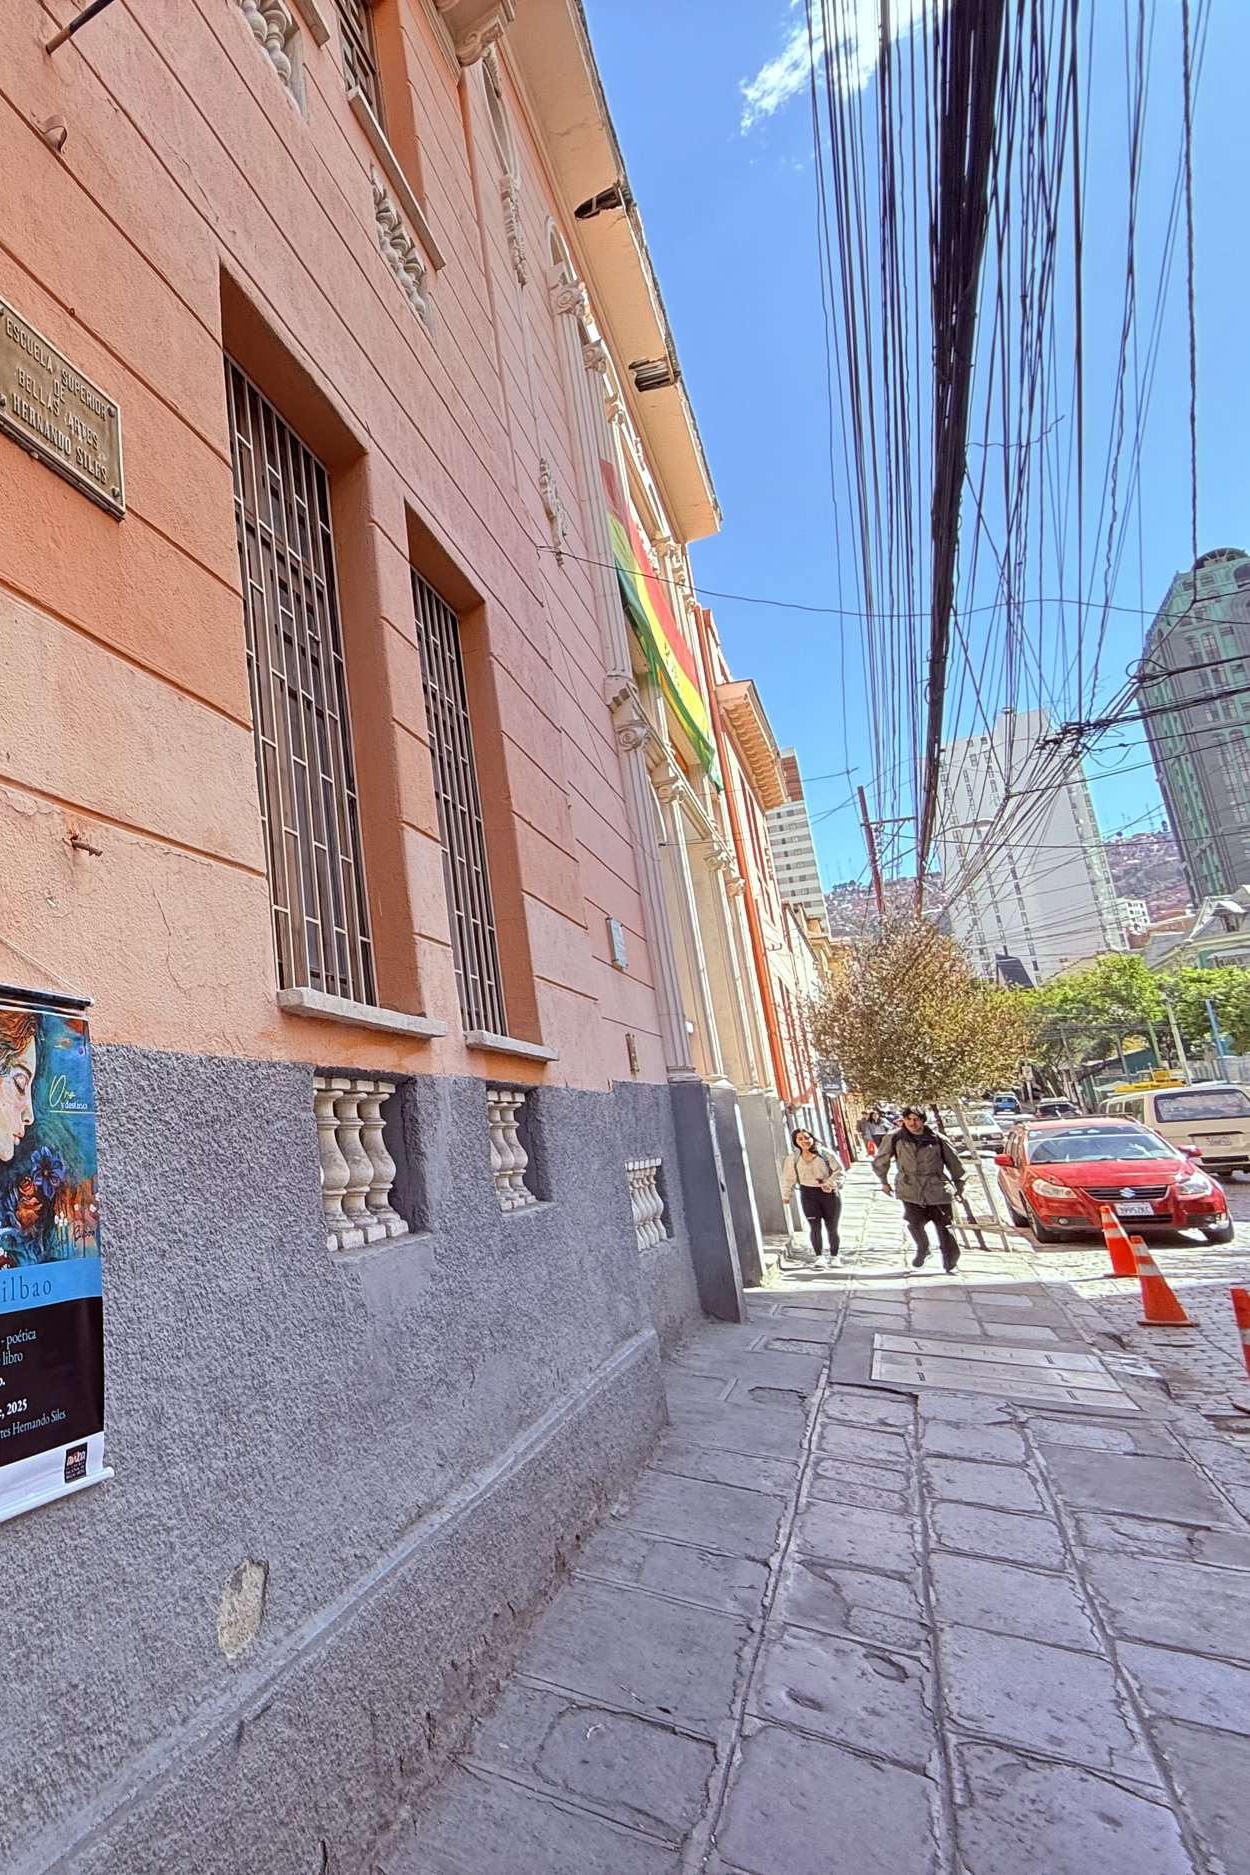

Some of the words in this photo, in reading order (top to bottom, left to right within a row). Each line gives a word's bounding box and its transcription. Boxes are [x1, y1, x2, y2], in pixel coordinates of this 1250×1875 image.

[6, 316, 53, 374] ESCUELA
[61, 368, 107, 422] SUPERIOR
[53, 379, 66, 404] DE
[17, 368, 60, 417] BELLAS
[67, 412, 99, 450] ARTES
[12, 393, 71, 455] HERNANDO
[76, 446, 107, 485] SILES
[65, 1100, 88, 1110] destino
[6, 1329, 37, 1350] poética
[3, 1350, 23, 1366] libro
[6, 1398, 28, 1415] 2025
[12, 1413, 50, 1435] Hernando
[51, 1408, 67, 1422] Siles
